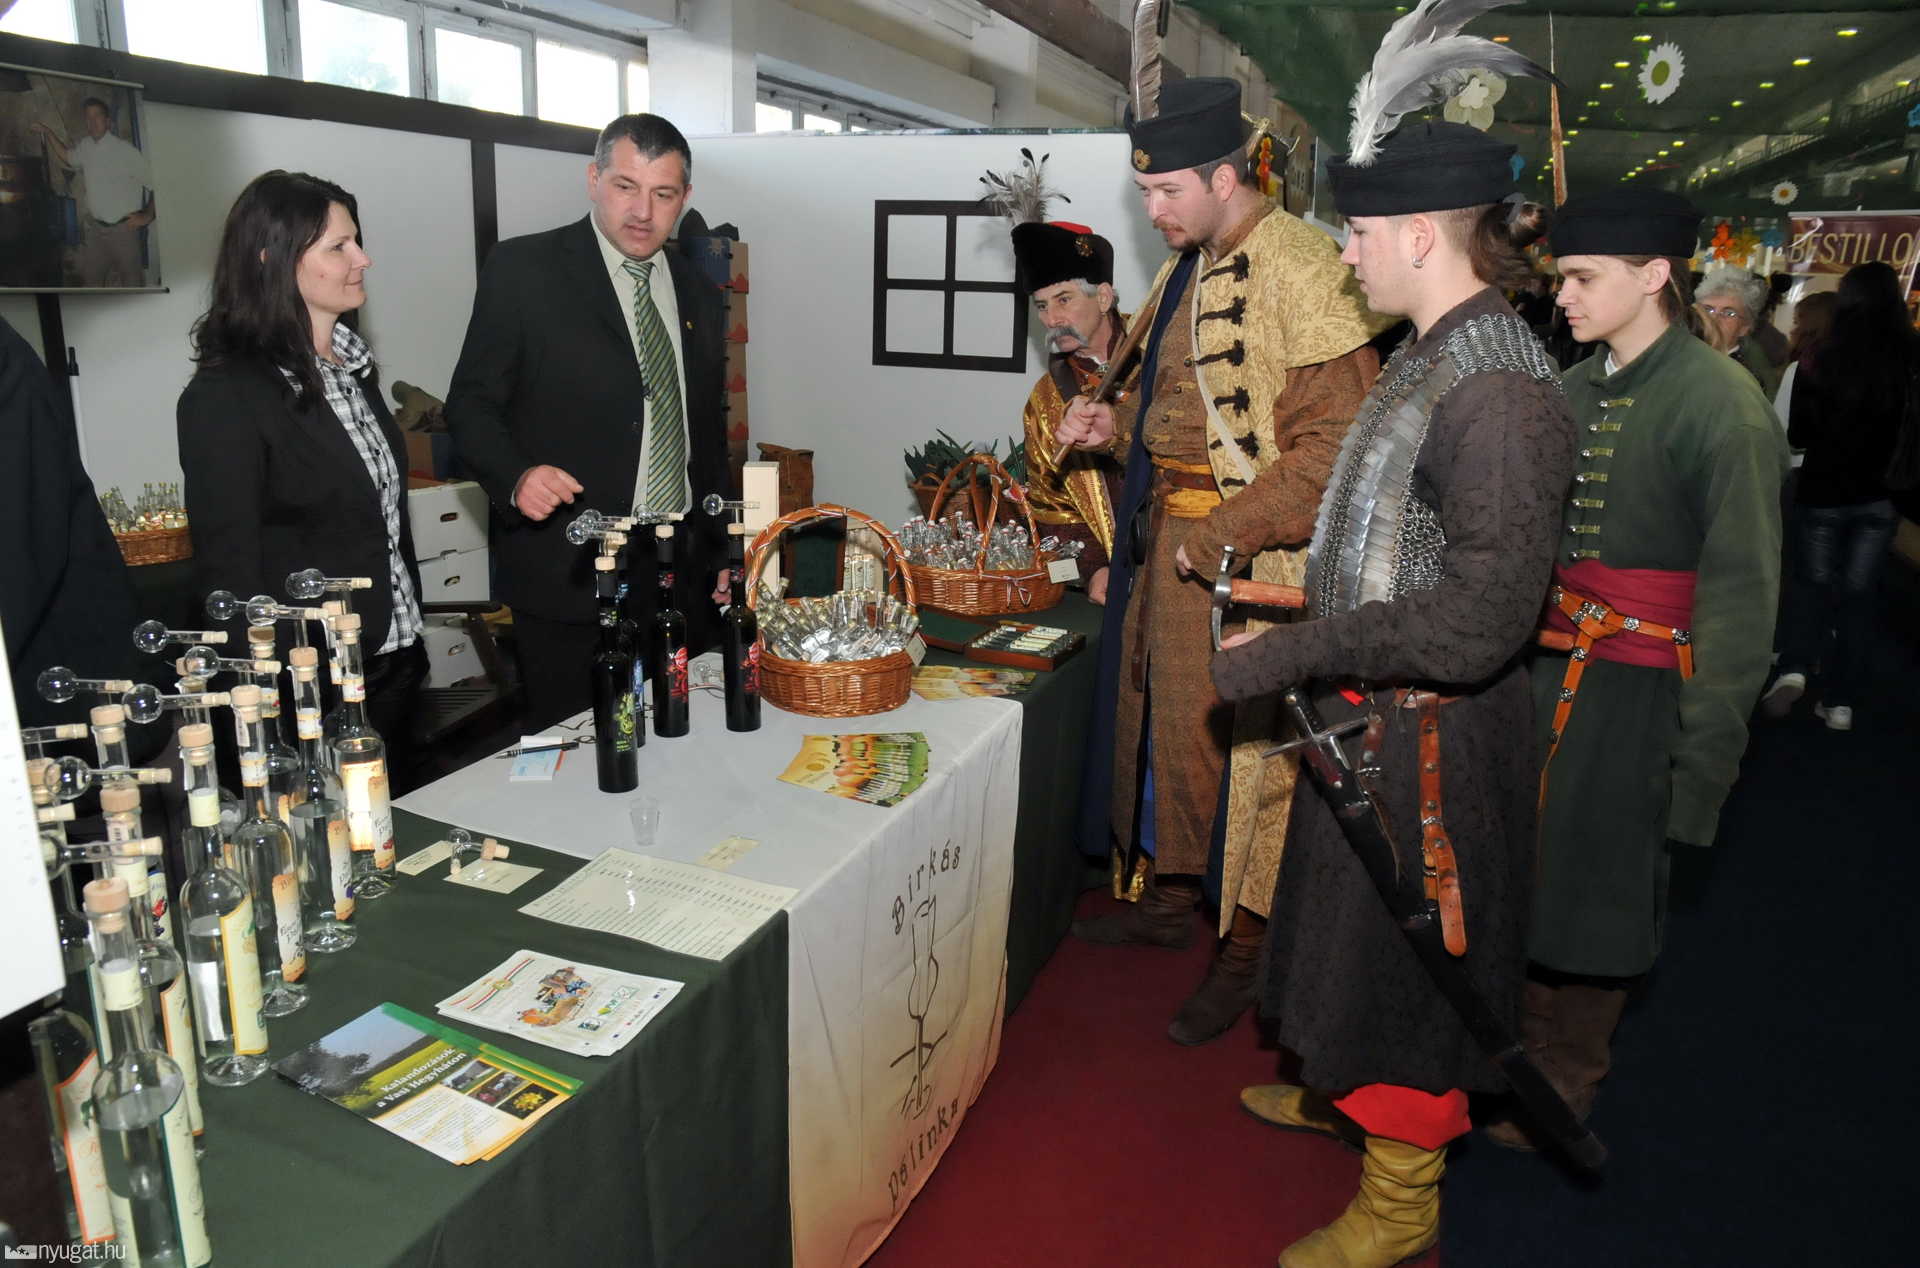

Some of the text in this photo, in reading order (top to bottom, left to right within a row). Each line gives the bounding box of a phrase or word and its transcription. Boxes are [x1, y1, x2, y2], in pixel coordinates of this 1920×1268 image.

[376, 1100, 387, 1109] a
[383, 1086, 411, 1102] Vasi
[888, 1096, 961, 1218] pálinka
